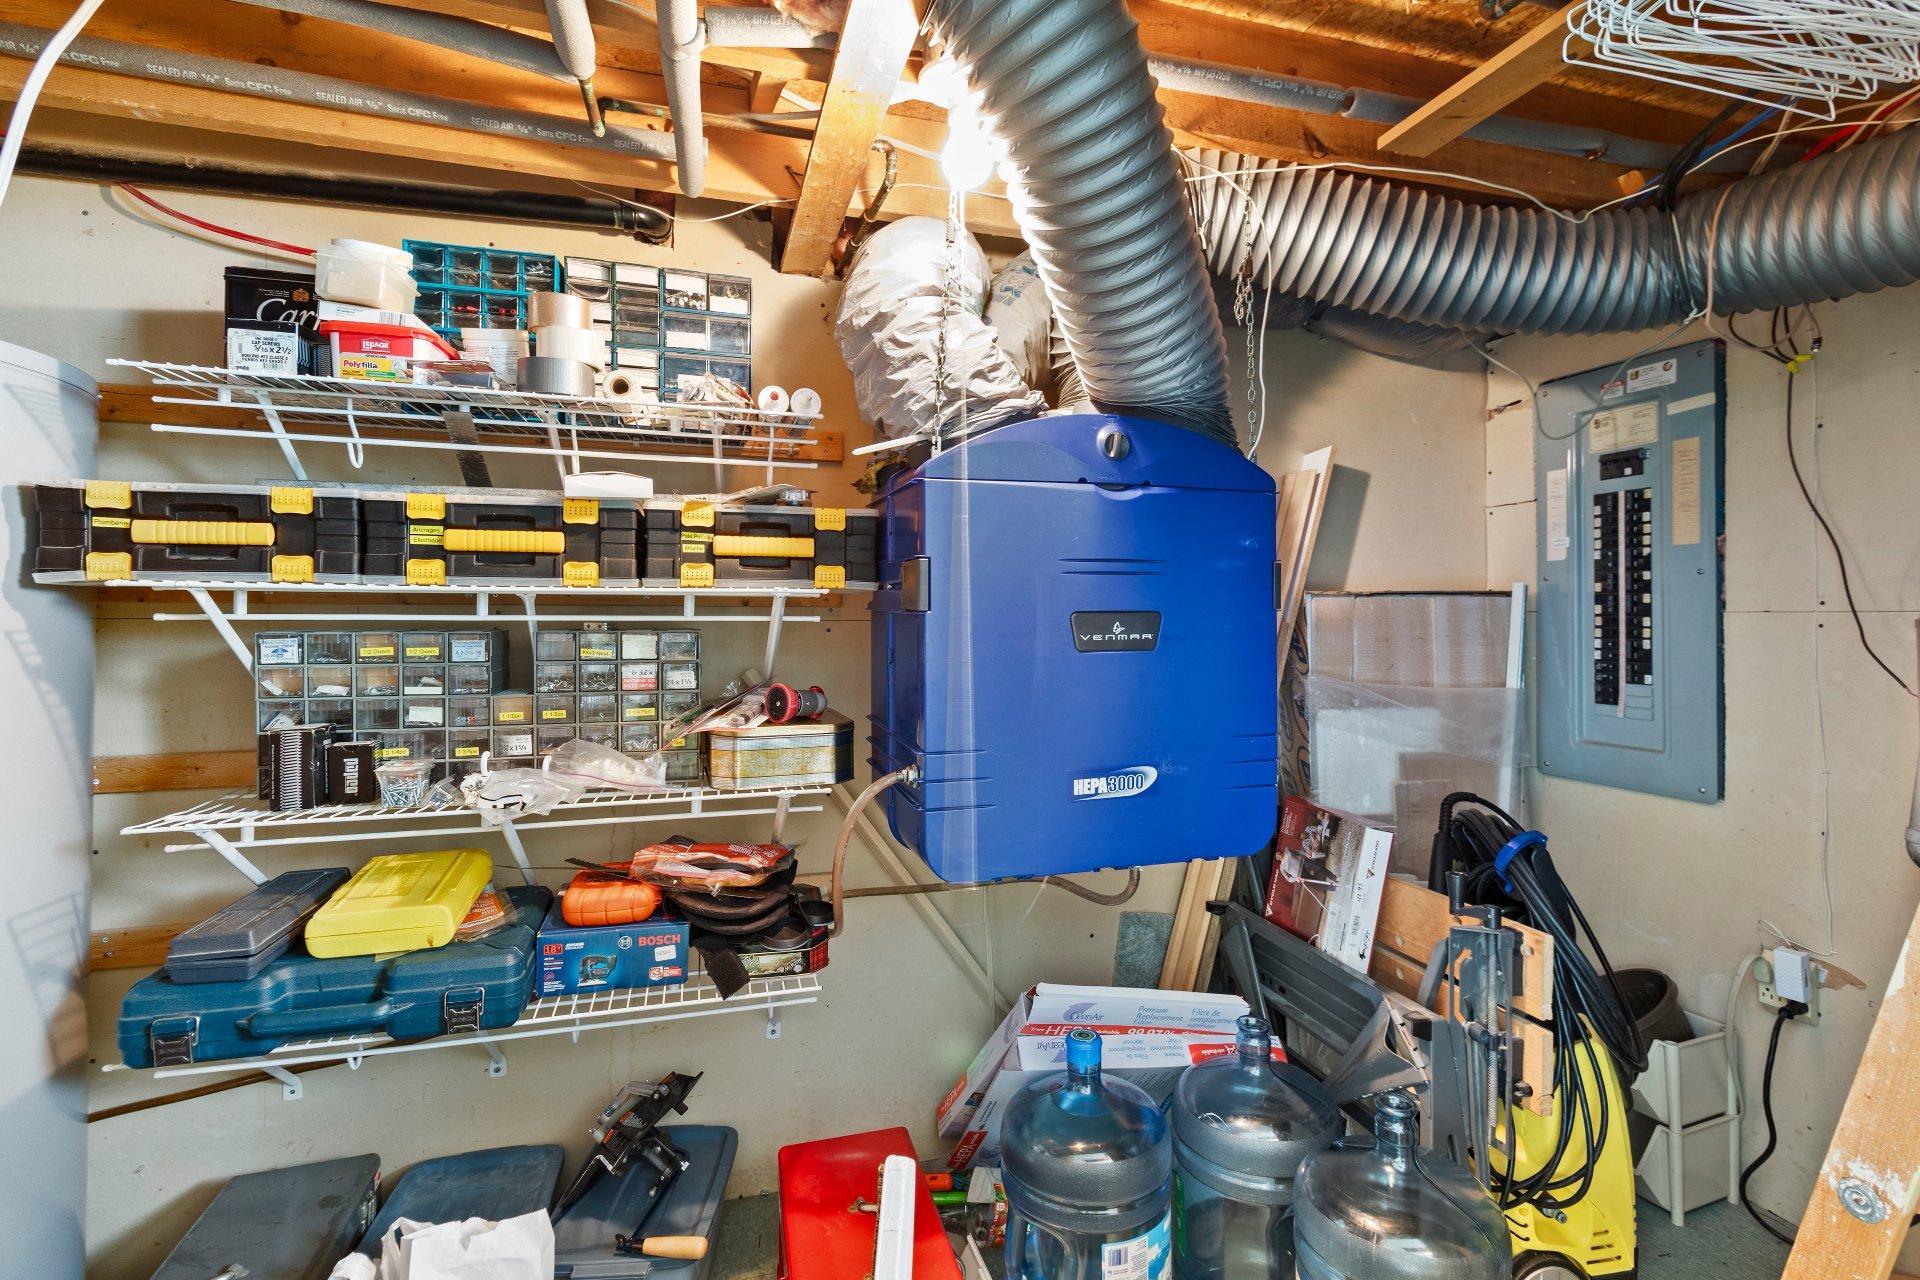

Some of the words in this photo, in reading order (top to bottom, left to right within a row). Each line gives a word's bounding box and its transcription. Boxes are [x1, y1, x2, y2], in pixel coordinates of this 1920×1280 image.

[69, 51, 99, 65] CFC
[146, 63, 180, 78] SEALED
[182, 70, 198, 80] AIR
[246, 81, 272, 93] CFC
[1263, 78, 1283, 90] CFC
[315, 91, 347, 104] SEALED
[348, 97, 363, 107] AIR
[407, 107, 432, 119] CFC
[471, 116, 500, 130] SEALED
[500, 120, 514, 131] AIR
[536, 127, 554, 138] Sans
[554, 130, 578, 143] CFC
[577, 134, 594, 144] Free
[614, 139, 641, 151] SEALED
[1079, 633, 1154, 642] VENMAR
[1073, 773, 1146, 796] HEPA3000
[638, 934, 681, 947] BOSCH
[1136, 1013, 1184, 1022] Replacement
[1138, 1005, 1169, 1014] Premium
[1191, 1008, 1212, 1017] Filtre
[1212, 1009, 1221, 1017] de
